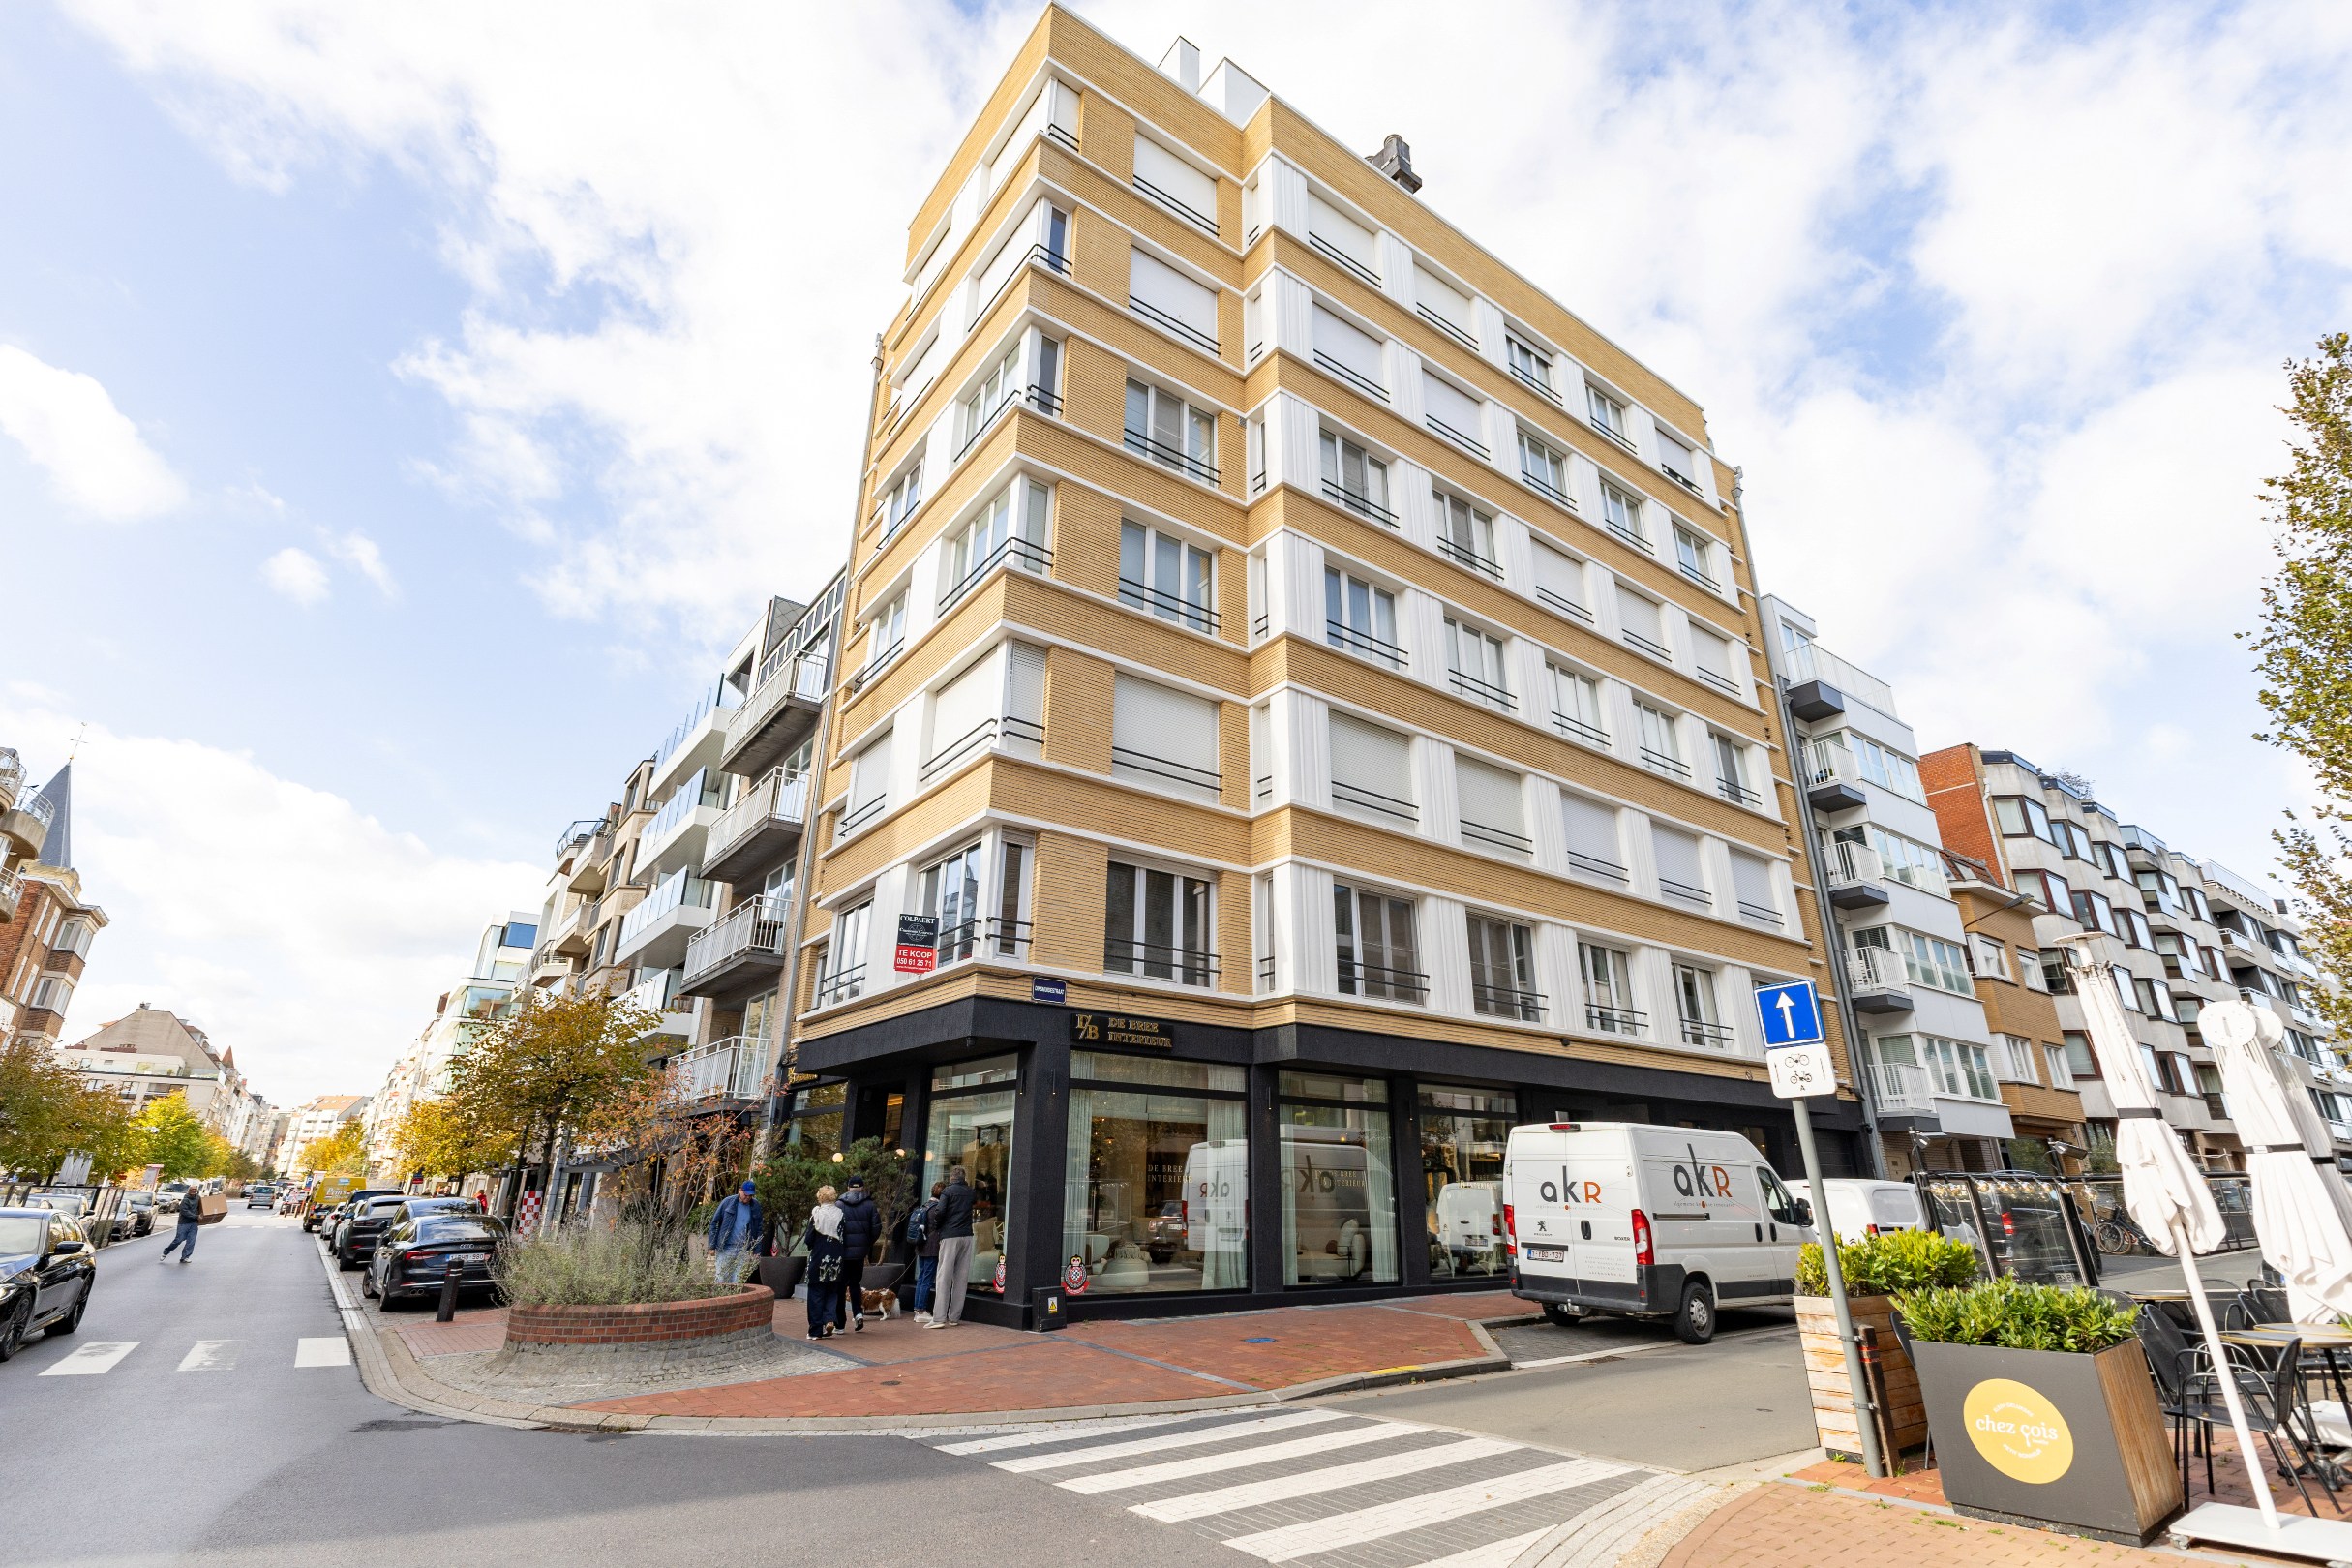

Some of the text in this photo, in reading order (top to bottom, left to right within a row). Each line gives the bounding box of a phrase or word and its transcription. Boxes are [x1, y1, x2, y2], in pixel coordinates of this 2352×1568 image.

[900, 915, 936, 924] COLPAERT
[1107, 1017, 1159, 1033] DE BREE
[1107, 1031, 1173, 1048] INTERIEUR
[1161, 1164, 1183, 1173] BREE
[1147, 1174, 1192, 1184] INTERIEUR
[1975, 1414, 2016, 1435] chez
